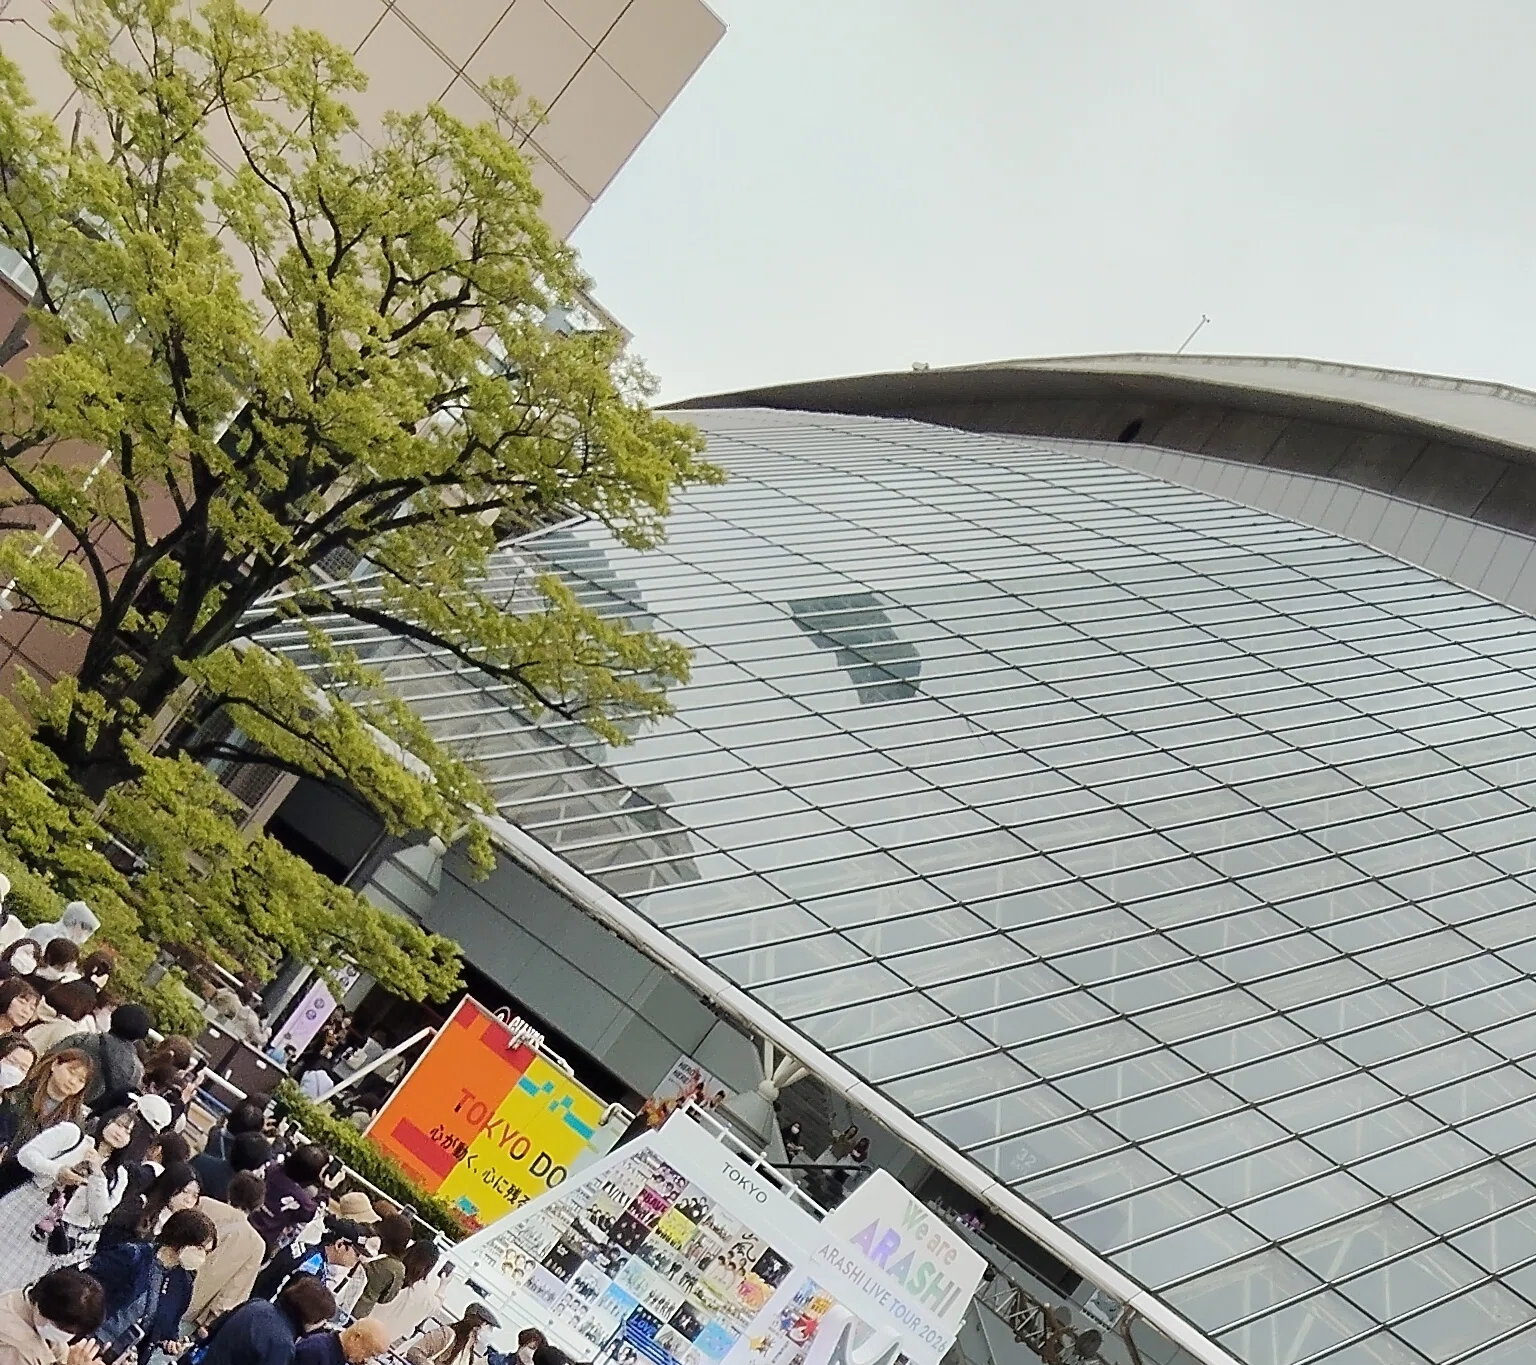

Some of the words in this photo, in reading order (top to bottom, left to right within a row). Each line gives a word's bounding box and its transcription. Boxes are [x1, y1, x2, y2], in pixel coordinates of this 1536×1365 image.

[453, 1087, 532, 1161] TOKYO
[720, 1161, 768, 1204] TOKYO
[849, 1217, 962, 1319] ARASHI
[901, 1199, 929, 1241] We
[926, 1230, 958, 1266] are
[818, 1243, 867, 1285] ARASHI
[862, 1277, 892, 1307] LIVE
[888, 1298, 924, 1333] TOUR
[917, 1324, 947, 1354] 2026
